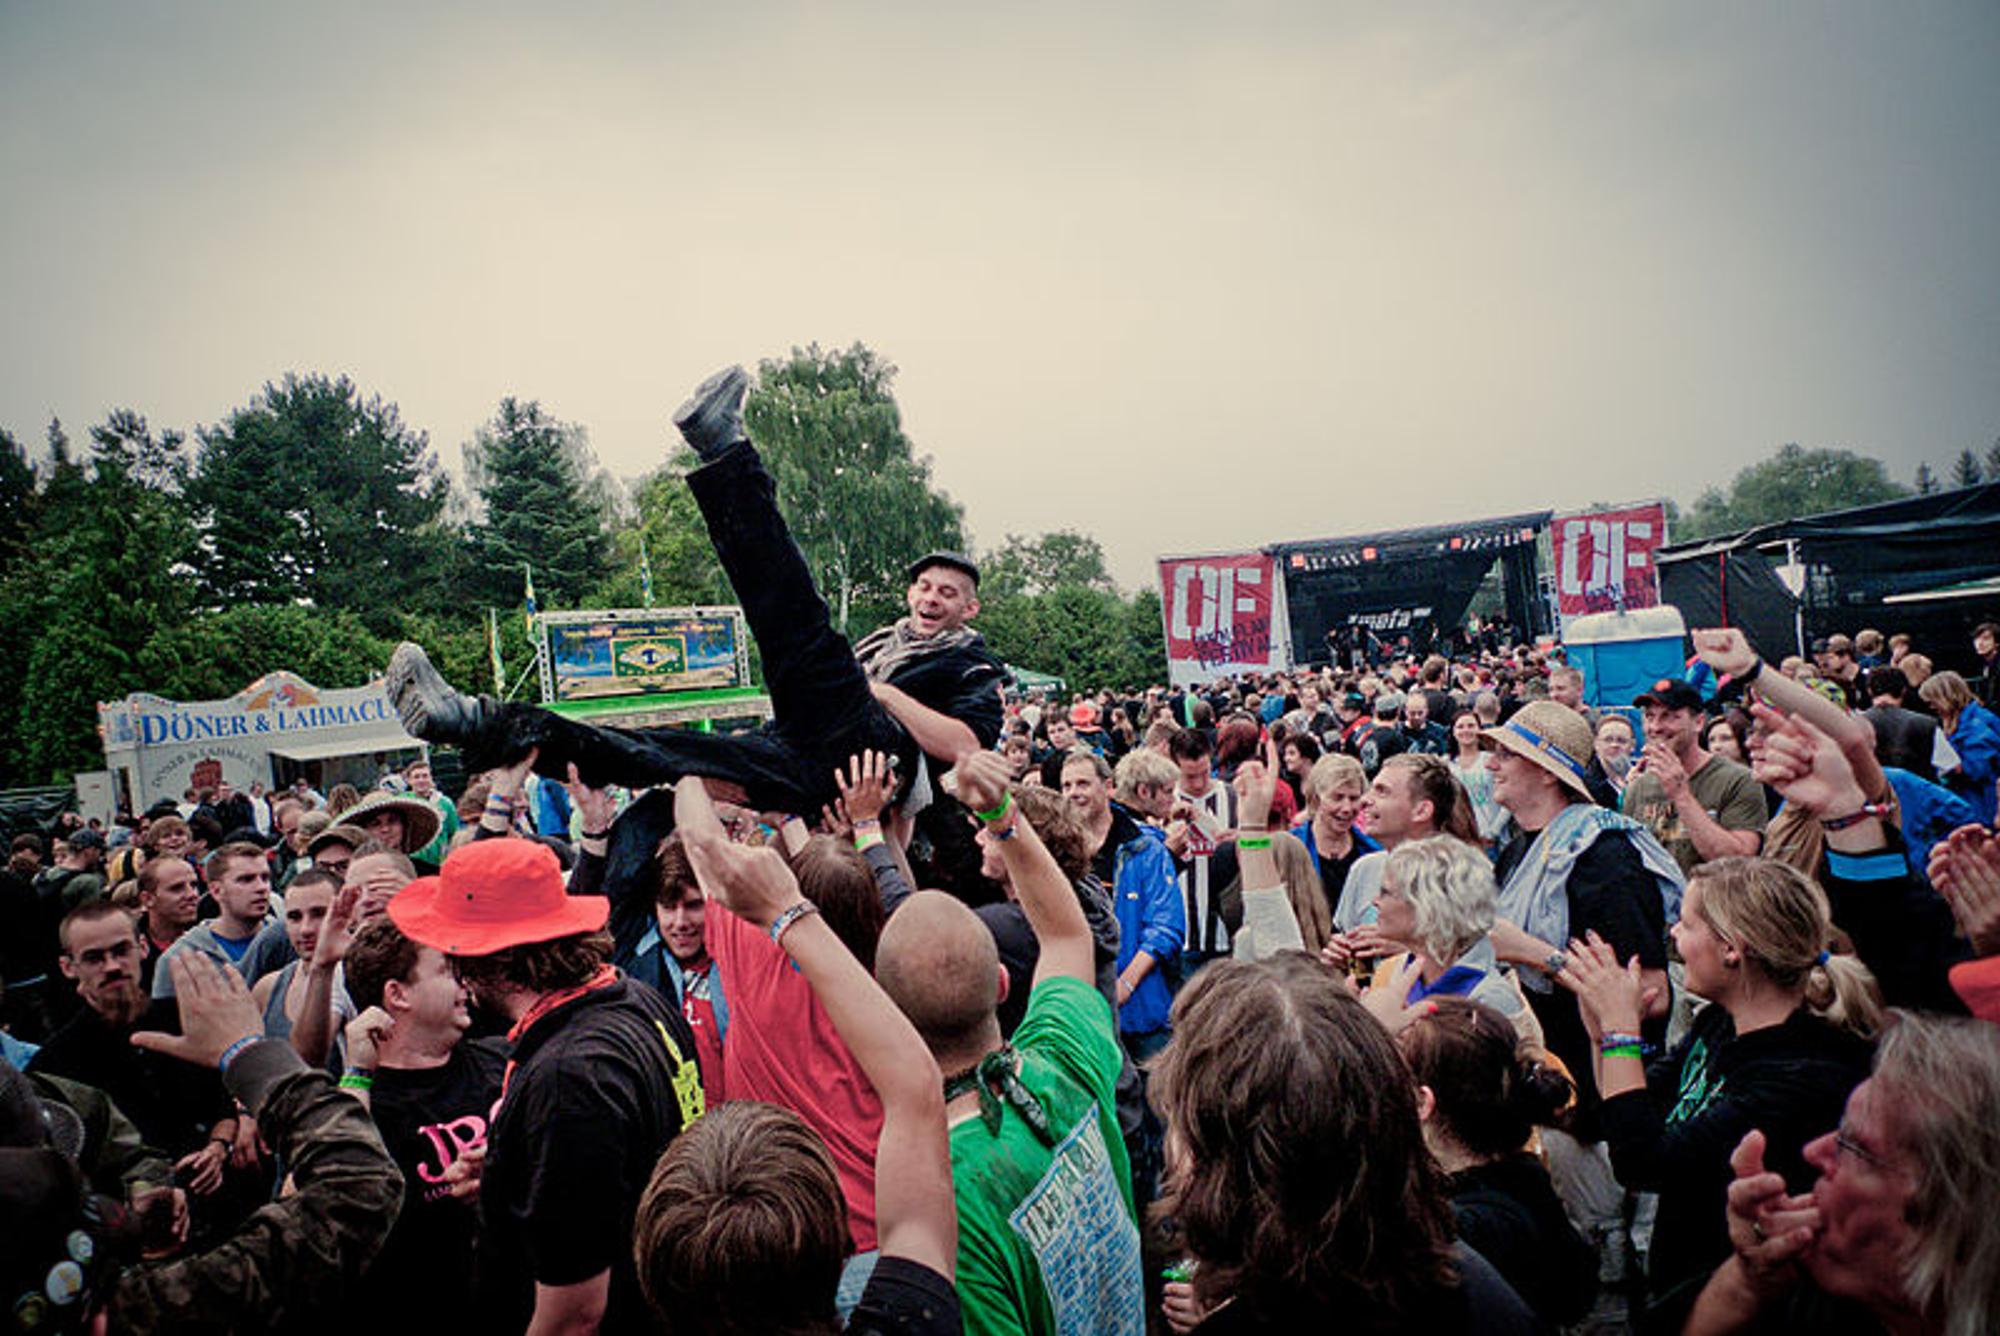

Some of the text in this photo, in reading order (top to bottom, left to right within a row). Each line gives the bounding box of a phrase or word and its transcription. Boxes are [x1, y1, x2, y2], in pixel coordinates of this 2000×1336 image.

[1561, 519, 1652, 596] OF
[1171, 565, 1261, 641] OF
[142, 713, 248, 745] DÖNER
[254, 714, 270, 732] &
[278, 698, 401, 730] LAHMACU
